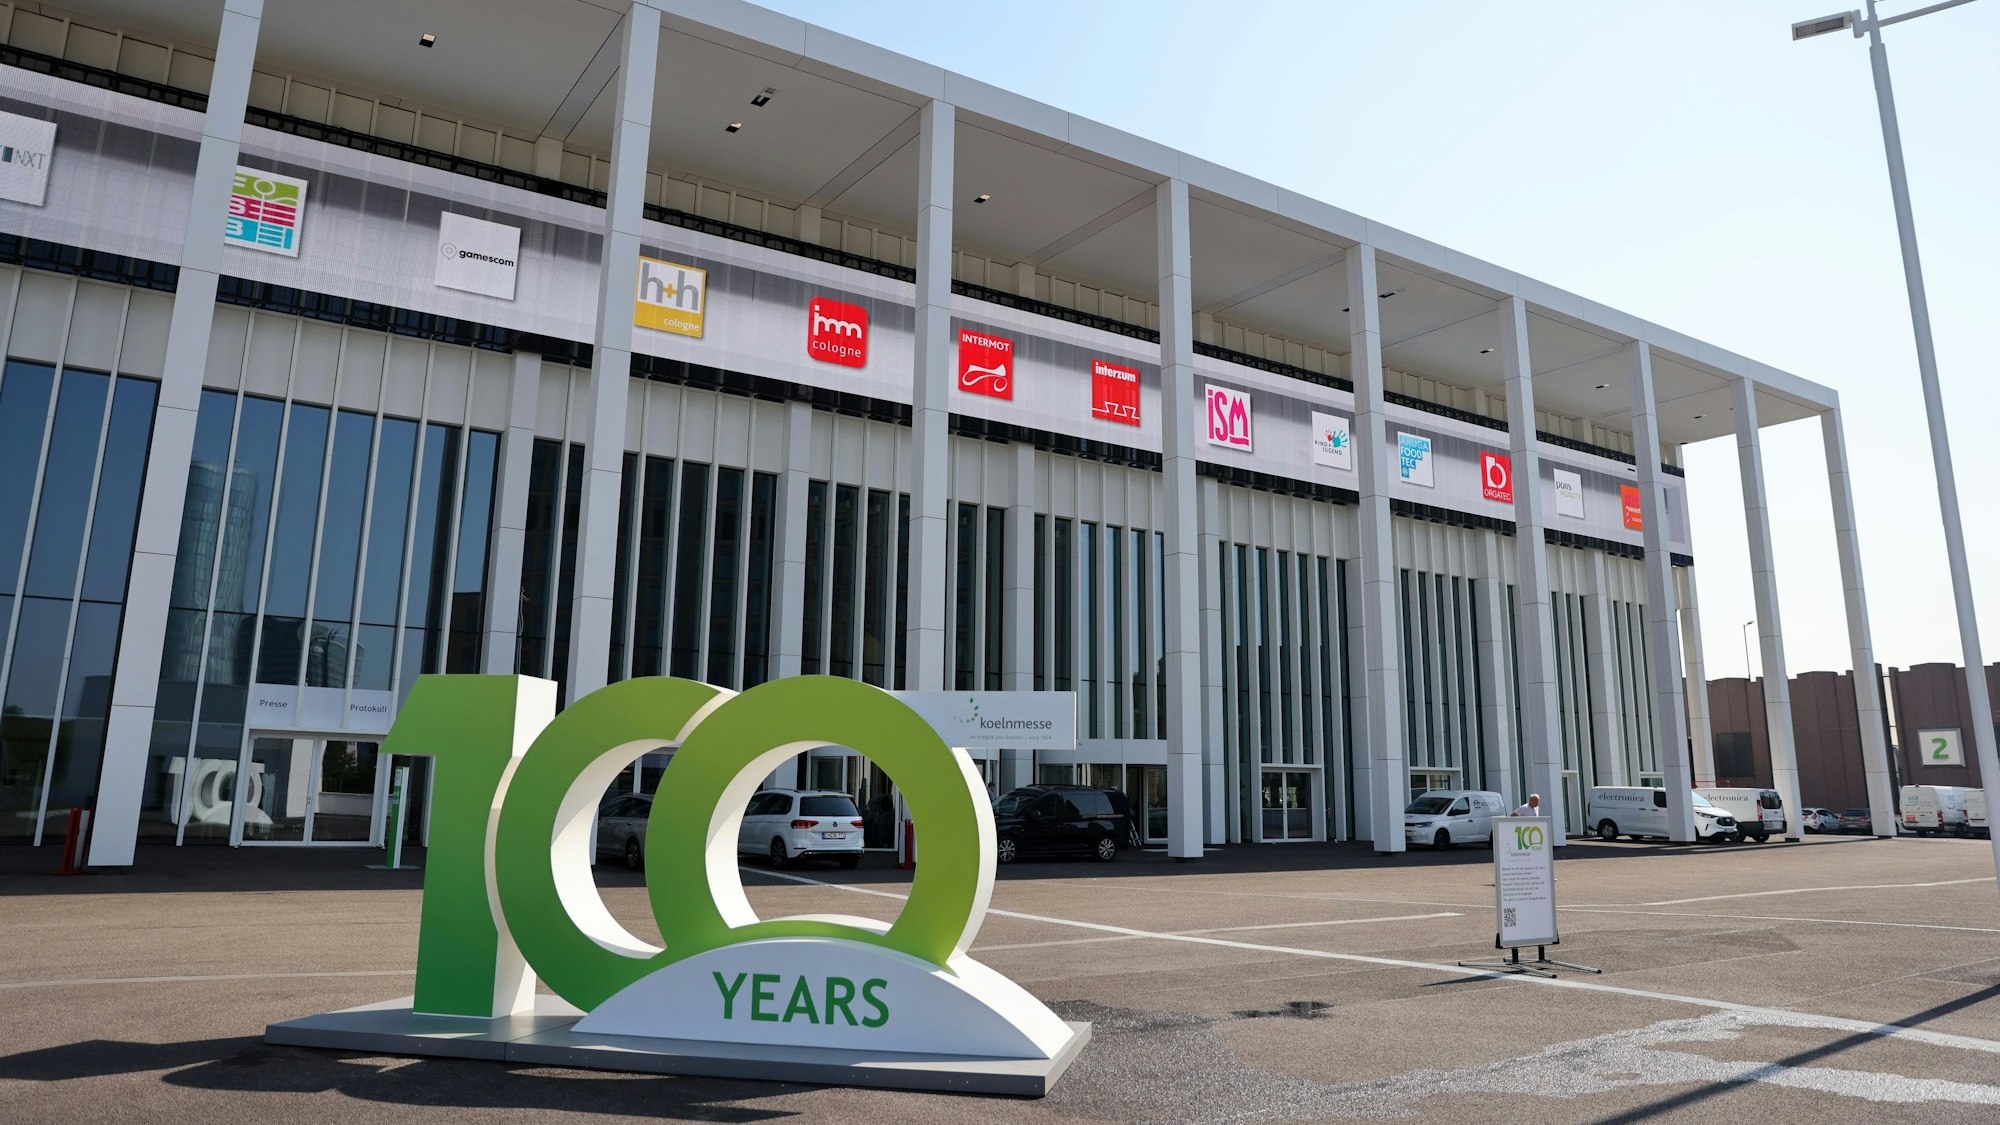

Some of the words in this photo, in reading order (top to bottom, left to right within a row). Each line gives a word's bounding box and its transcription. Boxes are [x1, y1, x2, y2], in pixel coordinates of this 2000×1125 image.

[459, 250, 514, 267] gamescom
[640, 262, 699, 311] h+h
[663, 318, 700, 331] cologne
[813, 304, 863, 339] imm
[812, 340, 862, 358] cologne
[962, 333, 1010, 351] INTERMOT
[1095, 362, 1136, 382] interzum
[1322, 446, 1343, 456] JUGEND
[1400, 435, 1429, 451] ANUGA
[1400, 447, 1422, 459] FOOD
[1402, 456, 1416, 468] TEC
[1484, 488, 1511, 501] ORGATEC
[260, 699, 288, 709] Presse
[350, 703, 387, 713] Protokoll
[980, 716, 1052, 730] koelnmesse
[1931, 738, 1950, 759] 2
[1599, 792, 1645, 802] electronica
[1515, 826, 1544, 850] 100
[379, 673, 990, 1020] 100
[712, 971, 890, 1028] YEARS
